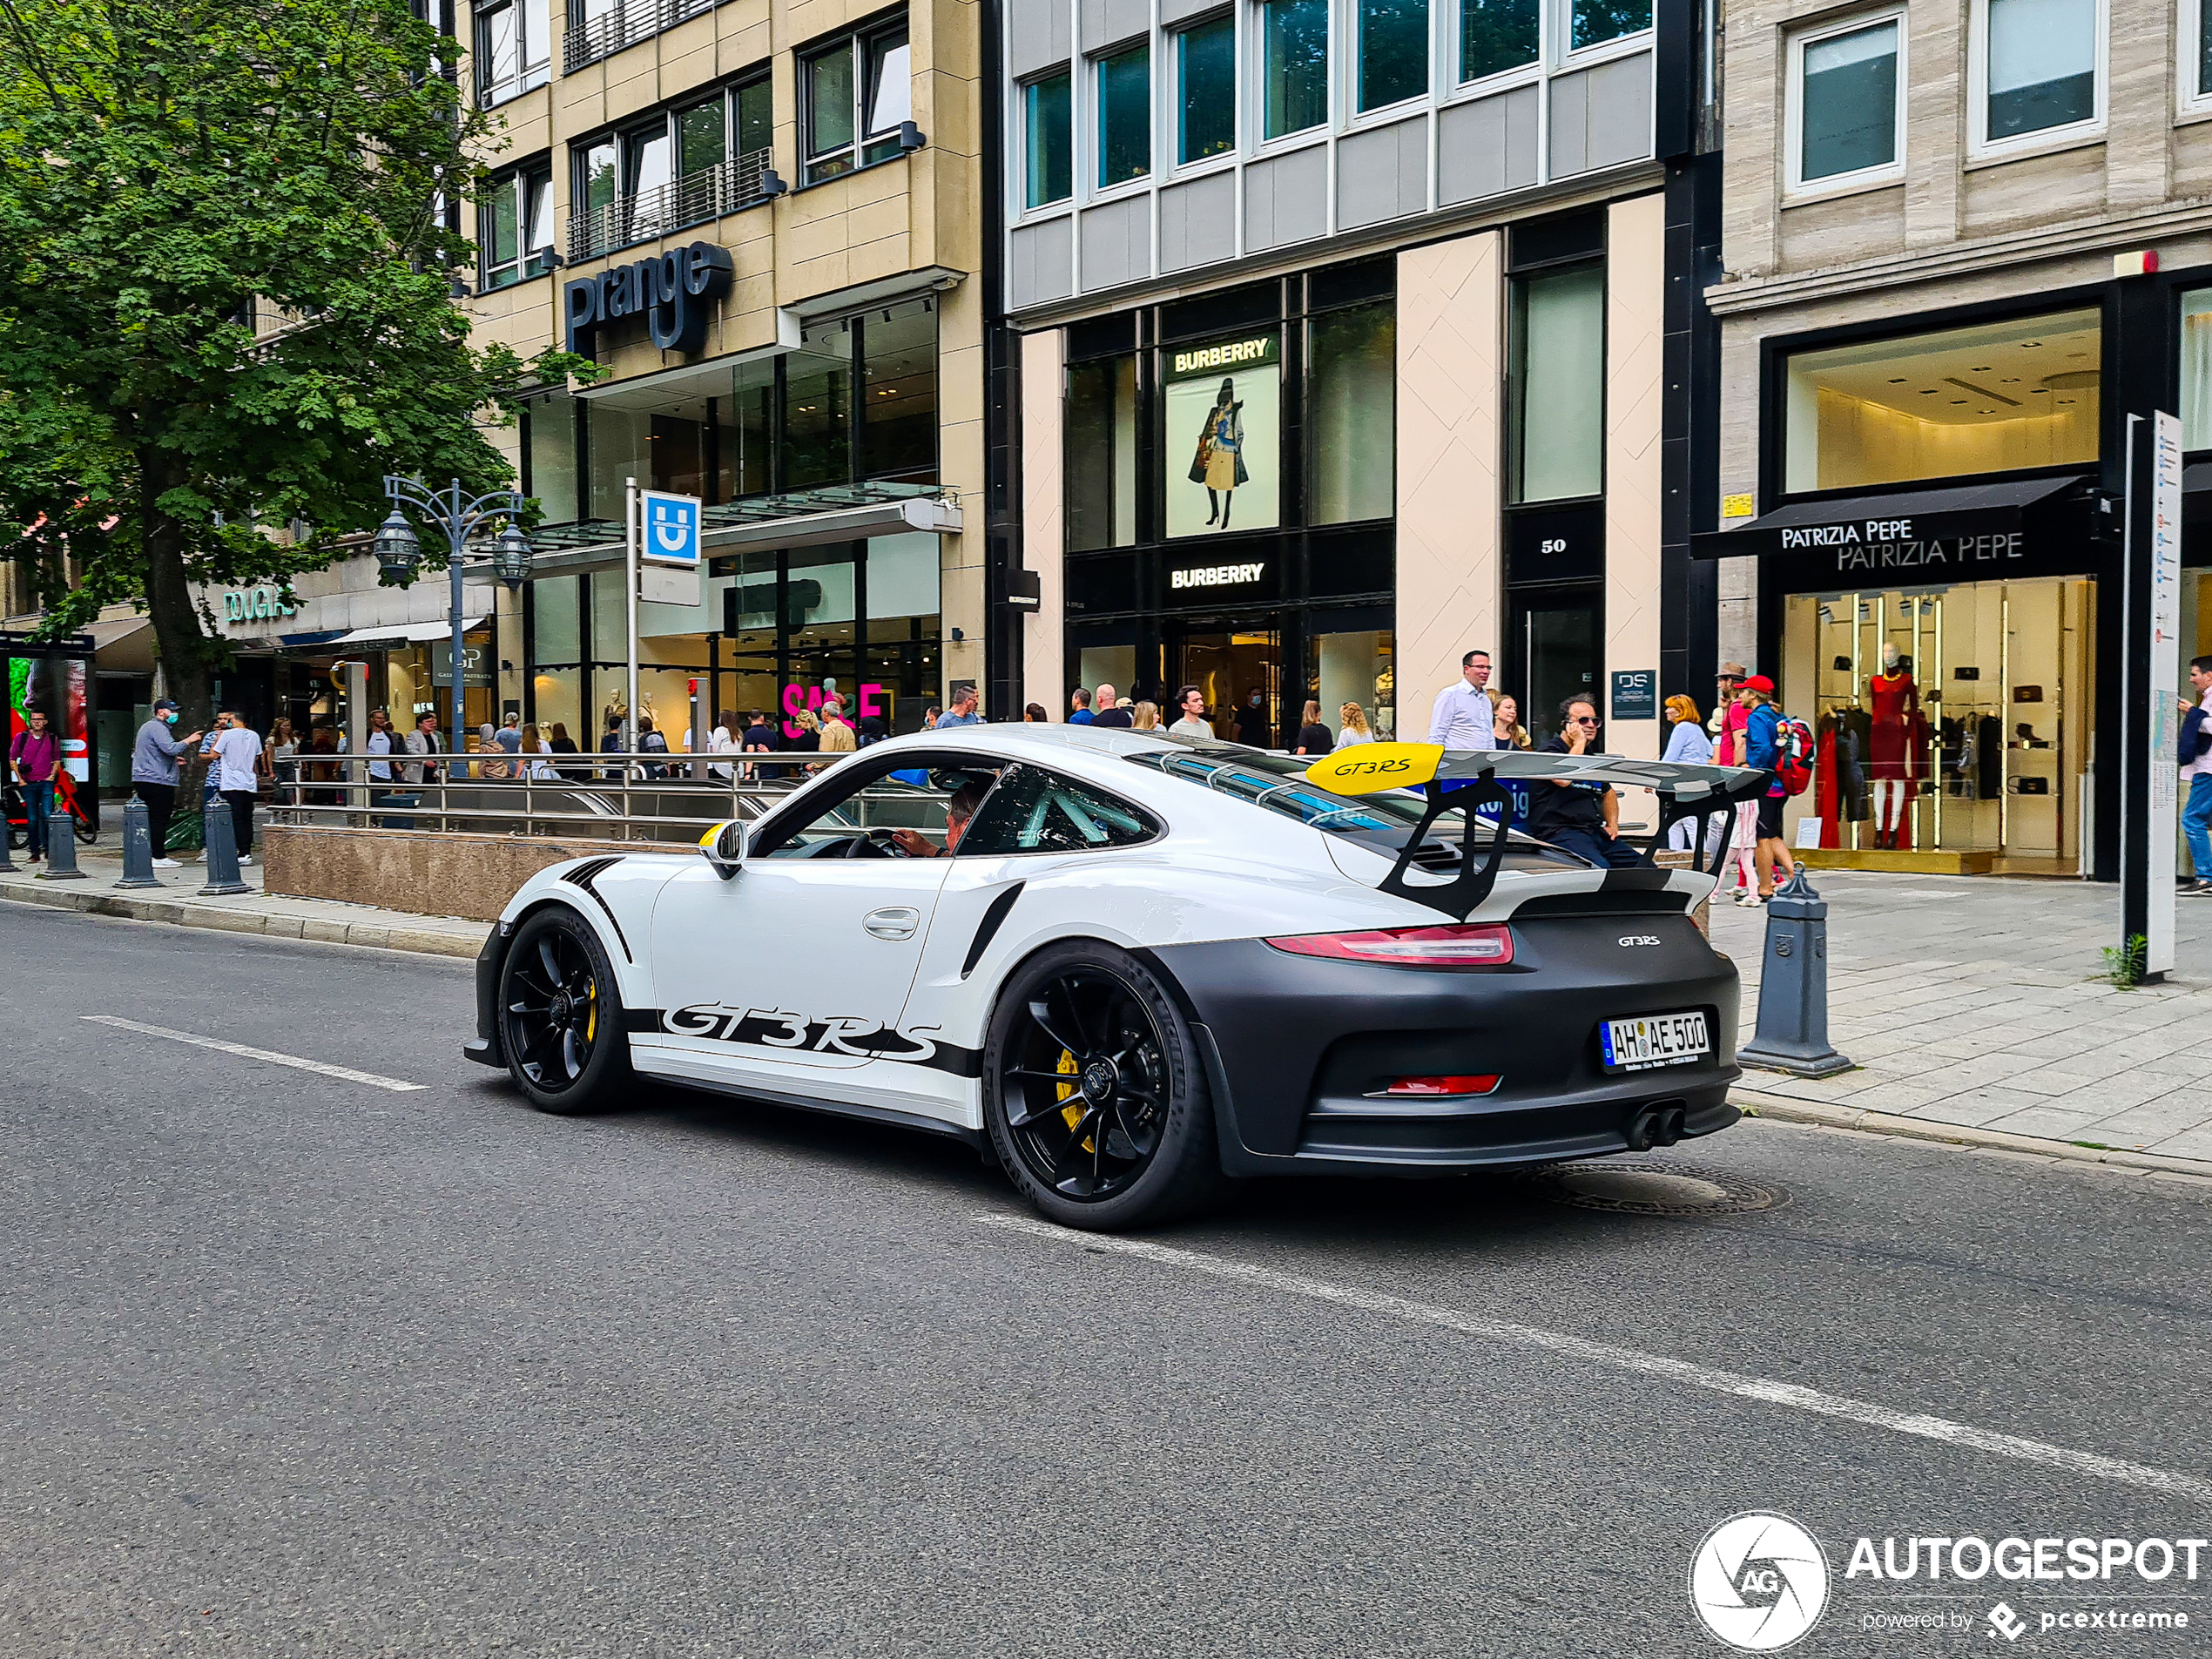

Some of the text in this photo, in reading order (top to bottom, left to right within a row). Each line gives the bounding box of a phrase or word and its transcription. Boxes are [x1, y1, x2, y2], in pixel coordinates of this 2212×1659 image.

[564, 241, 727, 356] prange
[1175, 337, 1269, 373] BURBERRY
[1541, 538, 1567, 554] 50
[1781, 520, 1912, 549] PATRIZIA PEPE
[1838, 532, 2024, 570] PATRIZIA PEPE
[1171, 563, 1264, 589] BURBERRY
[1618, 674, 1648, 688] DS
[1615, 1017, 1706, 1060] AH AE 500
